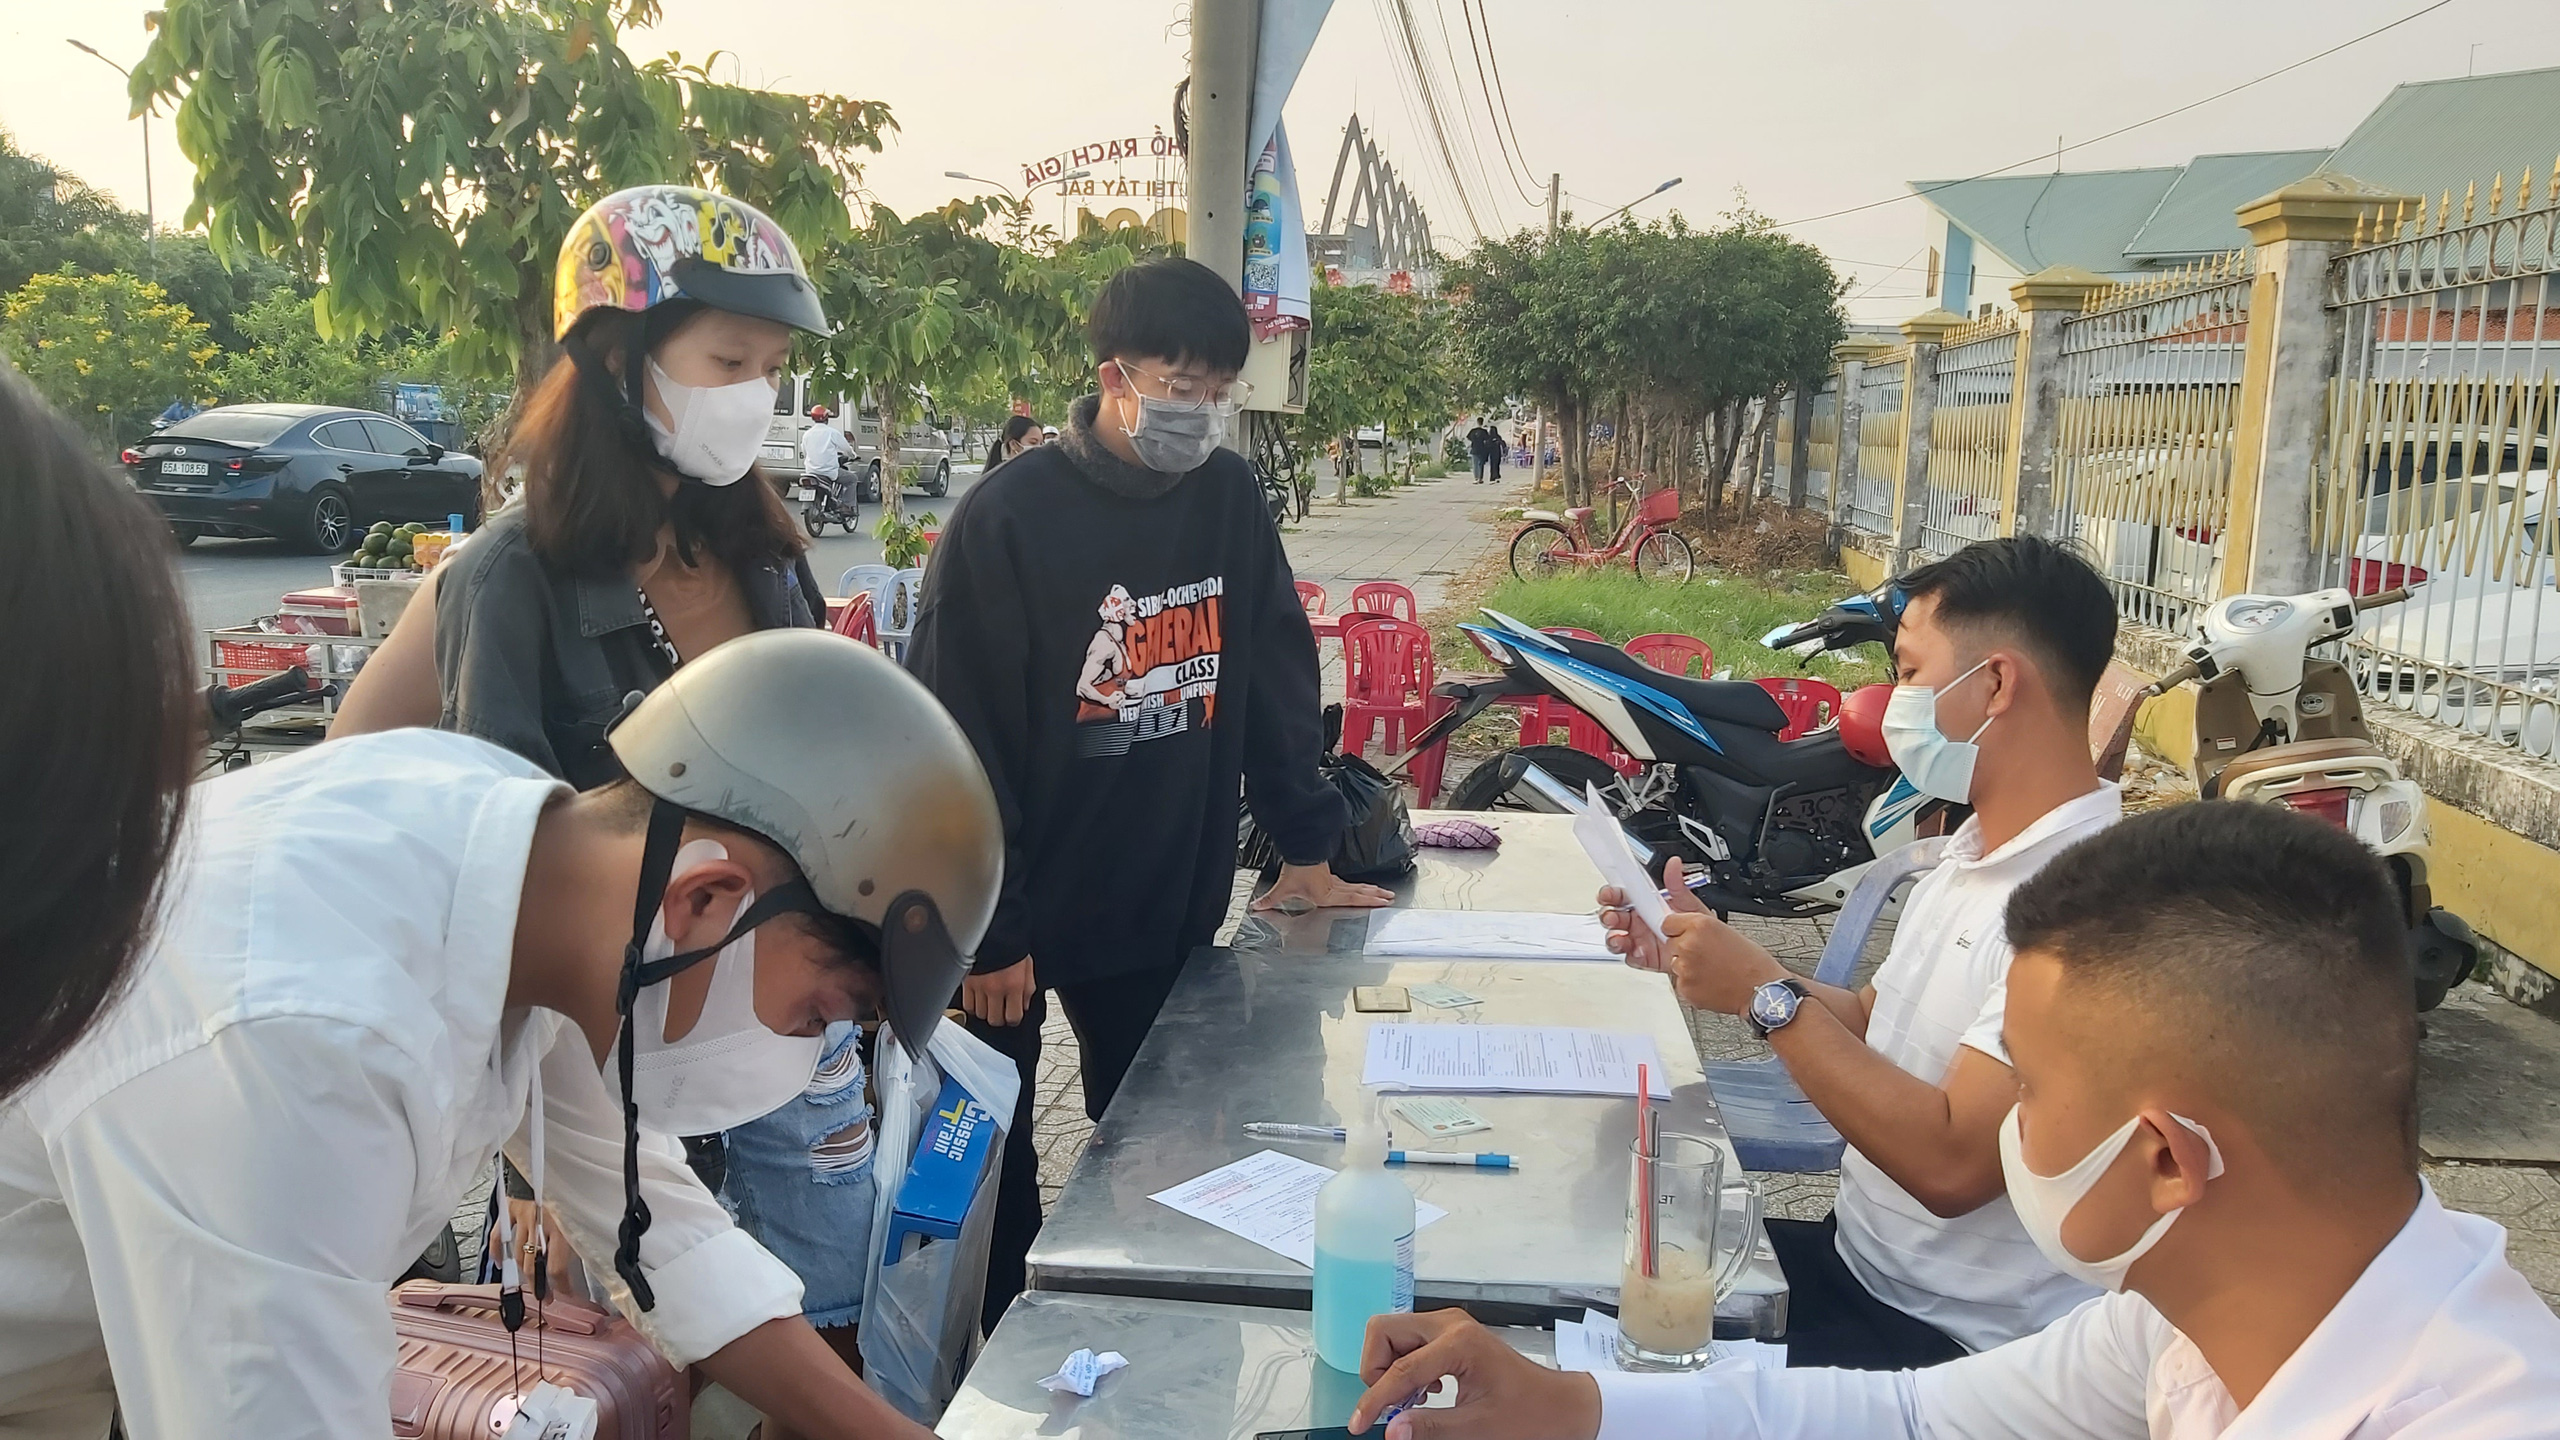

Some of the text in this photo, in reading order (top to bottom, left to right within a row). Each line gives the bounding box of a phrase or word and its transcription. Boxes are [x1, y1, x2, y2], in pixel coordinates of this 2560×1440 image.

[1175, 657, 1215, 685] CLASS
[933, 1097, 967, 1154] Train
[947, 1100, 991, 1162] Classic
